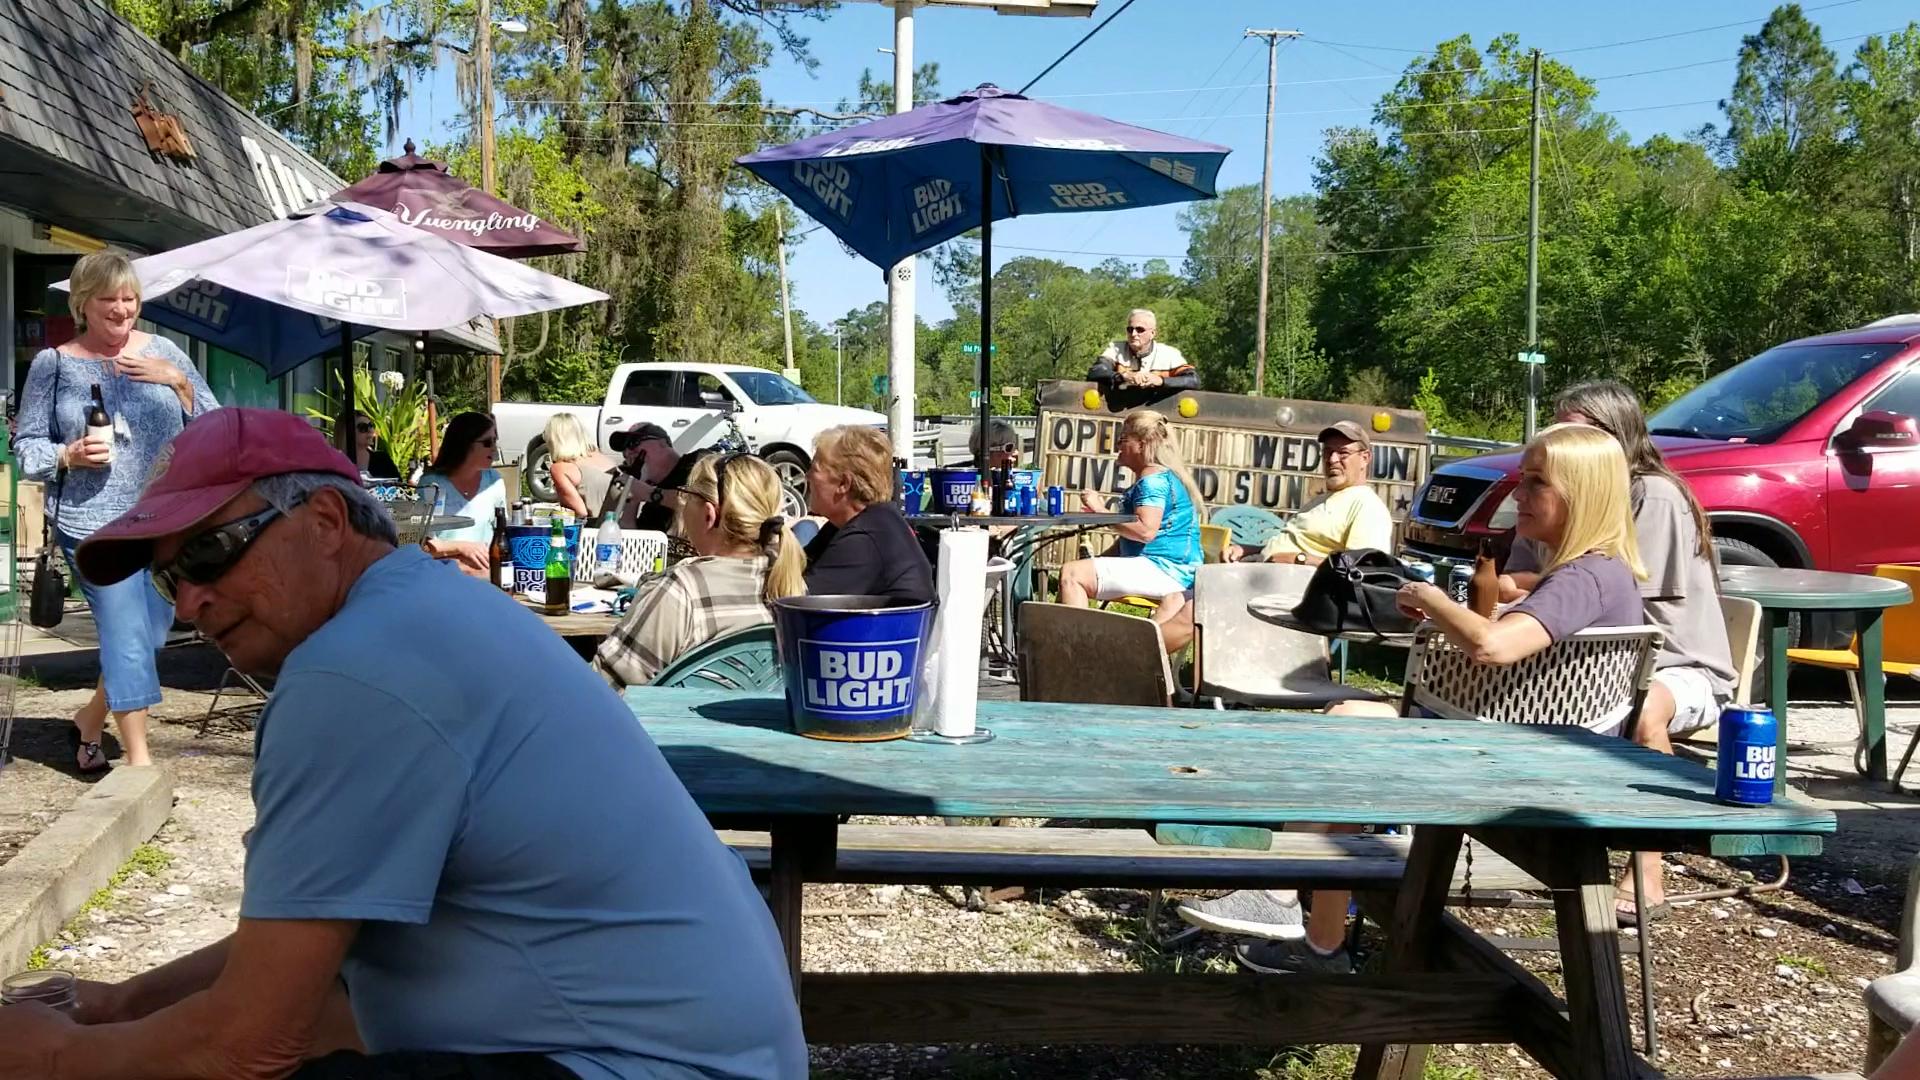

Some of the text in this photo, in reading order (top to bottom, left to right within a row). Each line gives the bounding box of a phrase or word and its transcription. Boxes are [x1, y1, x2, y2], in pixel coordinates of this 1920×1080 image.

[794, 160, 853, 217] LIGHT
[808, 160, 850, 190] UD
[1049, 182, 1107, 197] BUD
[912, 178, 952, 208] BUD
[1051, 191, 1128, 208] LIGHT
[391, 202, 541, 237] Yuengling
[911, 192, 963, 234] LIGHT
[1254, 434, 1321, 472] WED
[1374, 446, 1410, 481] UN
[1066, 456, 1127, 493] LIVE
[1234, 470, 1303, 510] SUN
[515, 569, 547, 584] BU
[819, 649, 903, 680] BUD
[807, 676, 911, 708] LIGHT
[1746, 745, 1776, 763] BU
